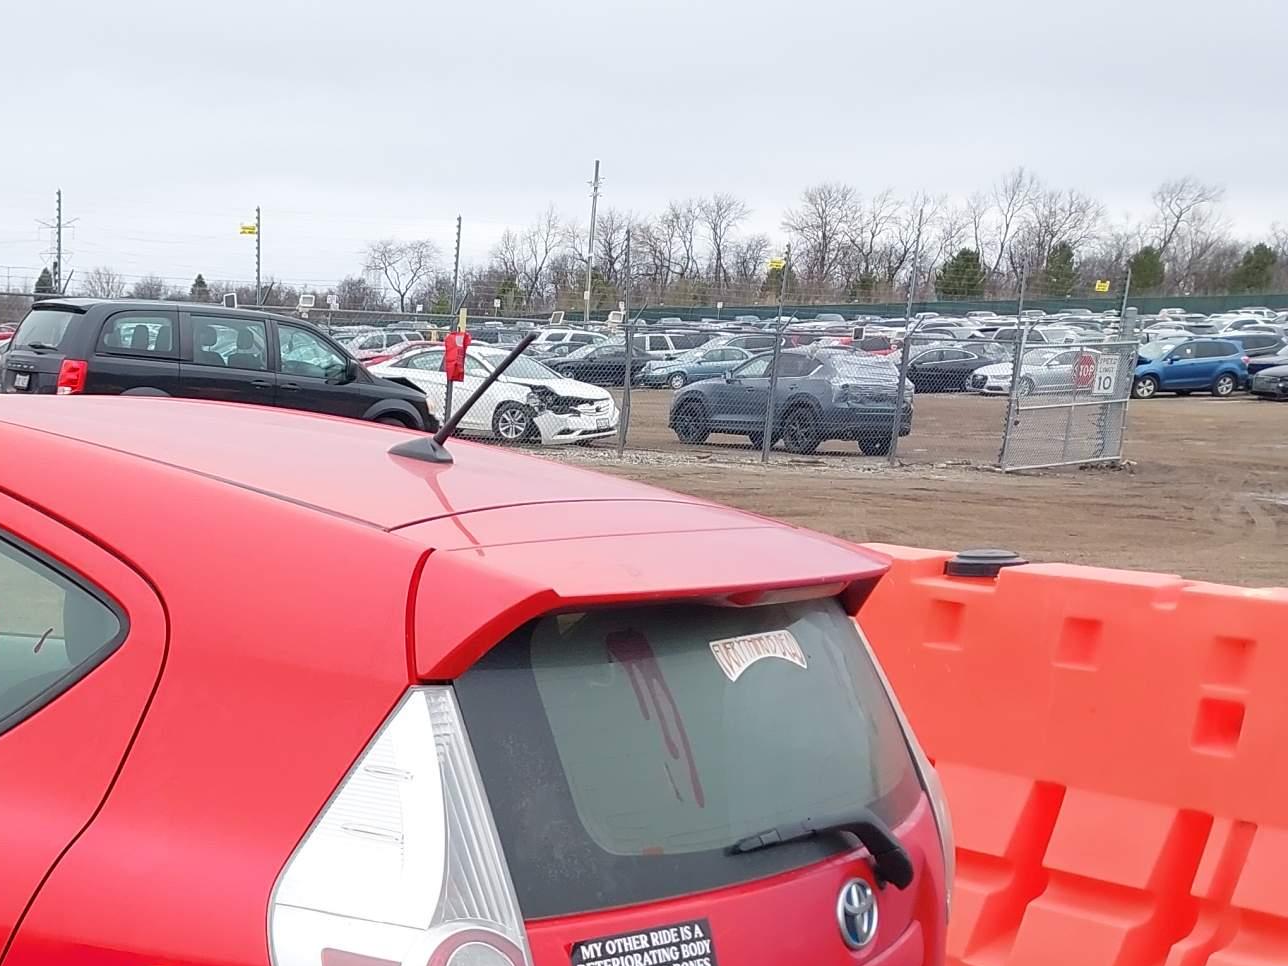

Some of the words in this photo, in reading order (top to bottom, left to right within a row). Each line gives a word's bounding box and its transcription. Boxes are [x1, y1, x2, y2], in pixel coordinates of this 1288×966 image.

[1097, 375, 1112, 390] 10
[580, 942, 603, 960] MY
[605, 934, 650, 955] OTHER
[650, 928, 680, 947] RIDE
[679, 925, 692, 941] IS
[694, 923, 704, 938] A
[680, 939, 711, 959] BODY
